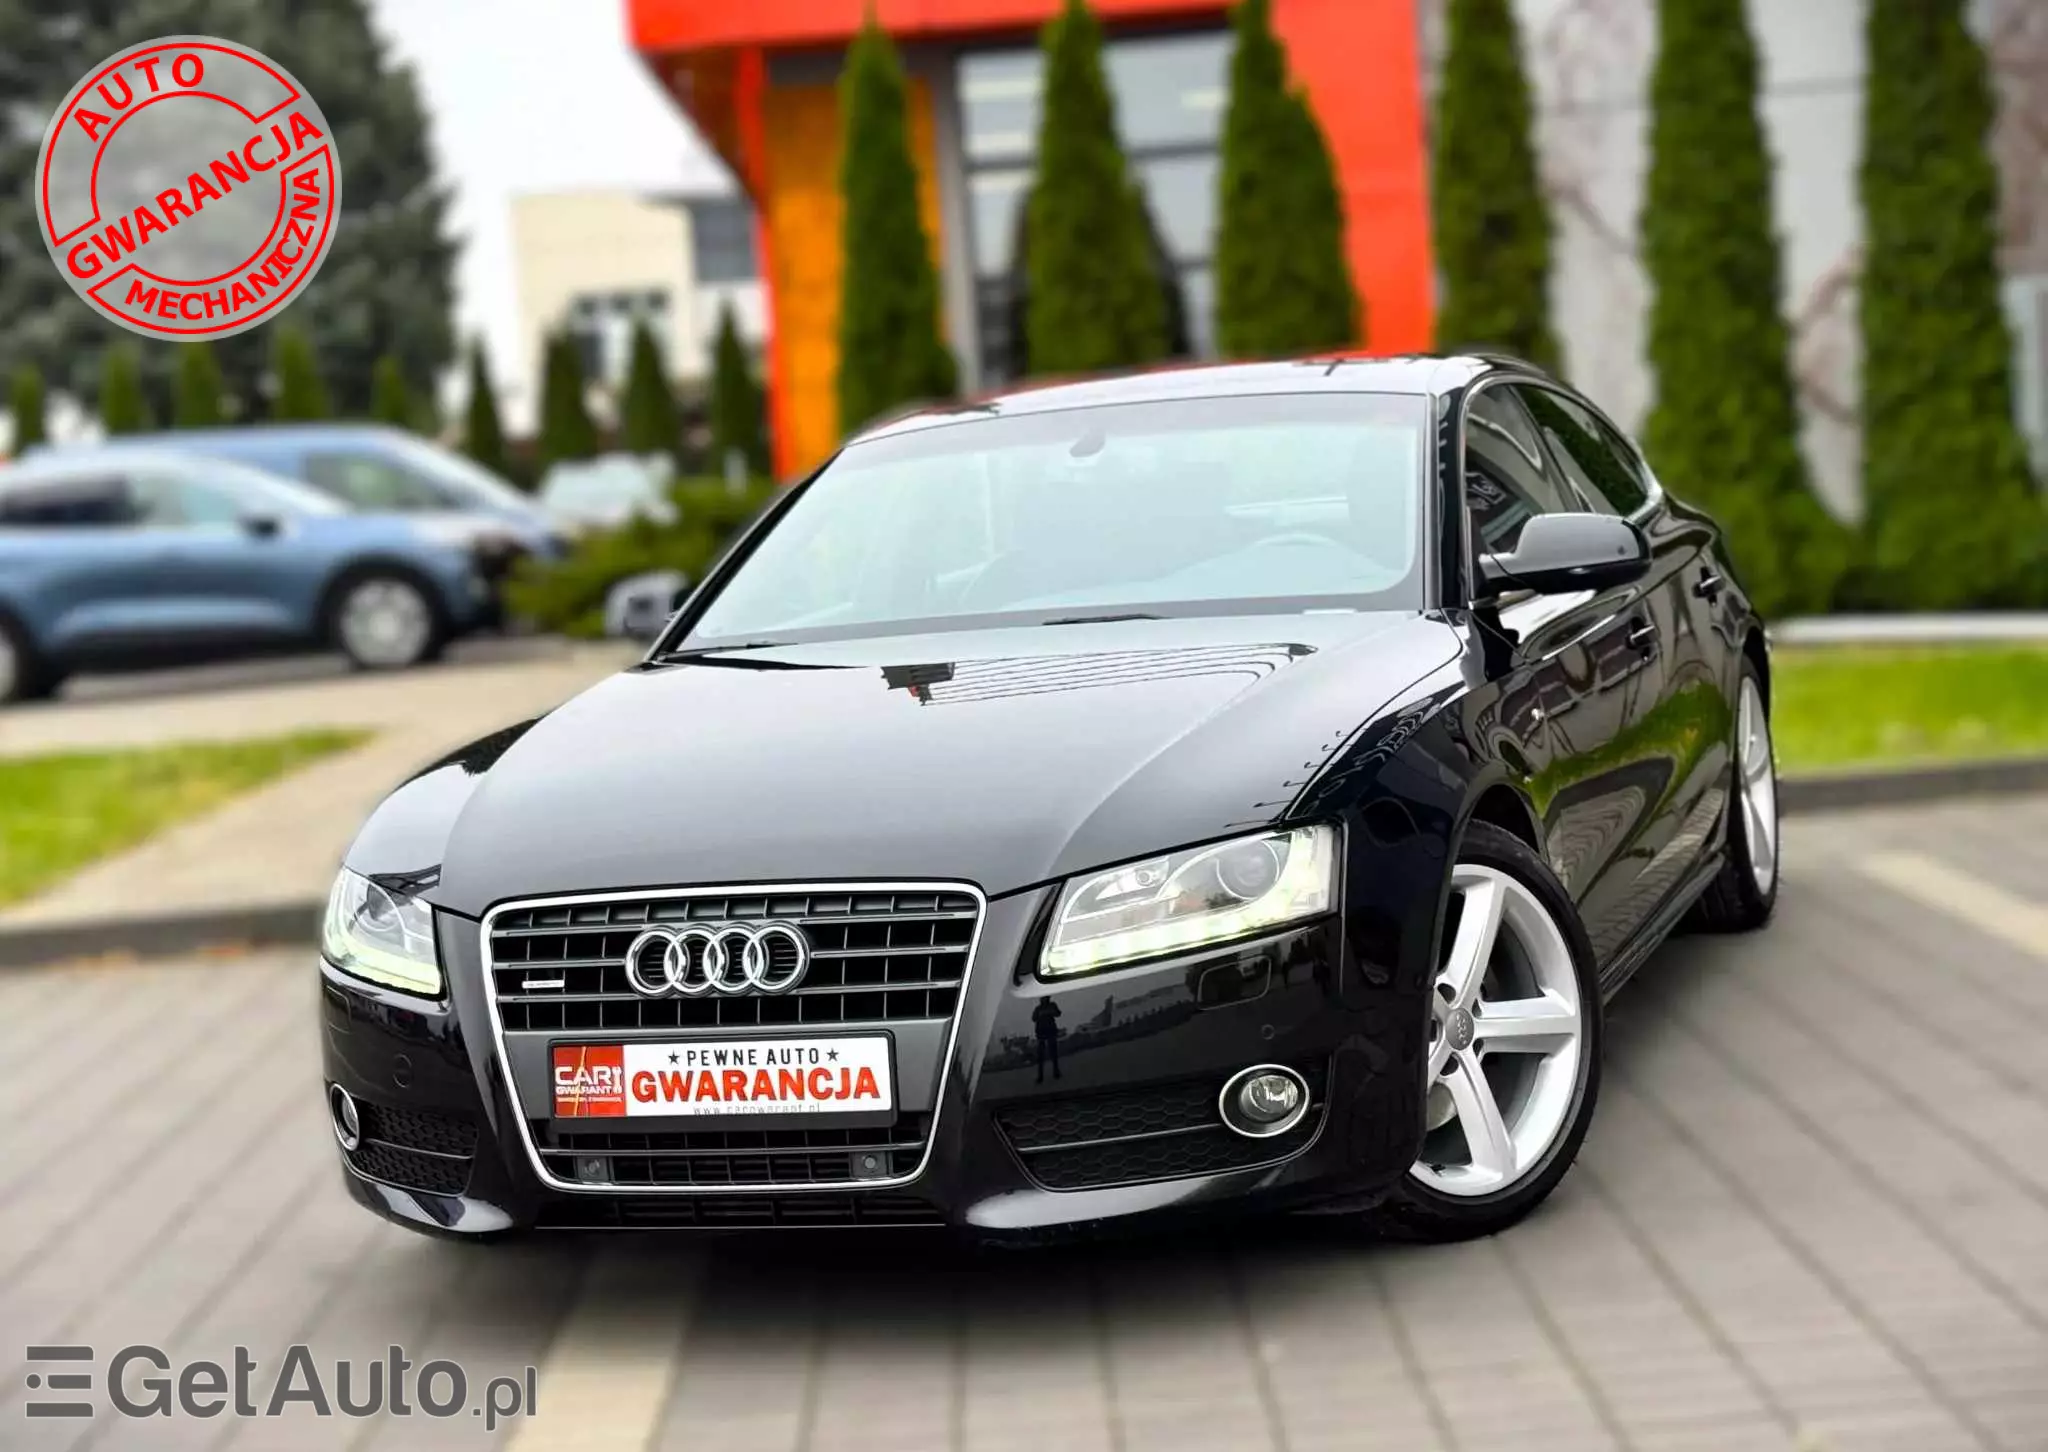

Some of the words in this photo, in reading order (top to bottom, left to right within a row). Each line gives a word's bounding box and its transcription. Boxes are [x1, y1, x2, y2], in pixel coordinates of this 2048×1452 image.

[686, 1048, 758, 1066] PEWNE
[766, 1047, 820, 1065] AUTO
[631, 1067, 880, 1102] GWARANCJA
